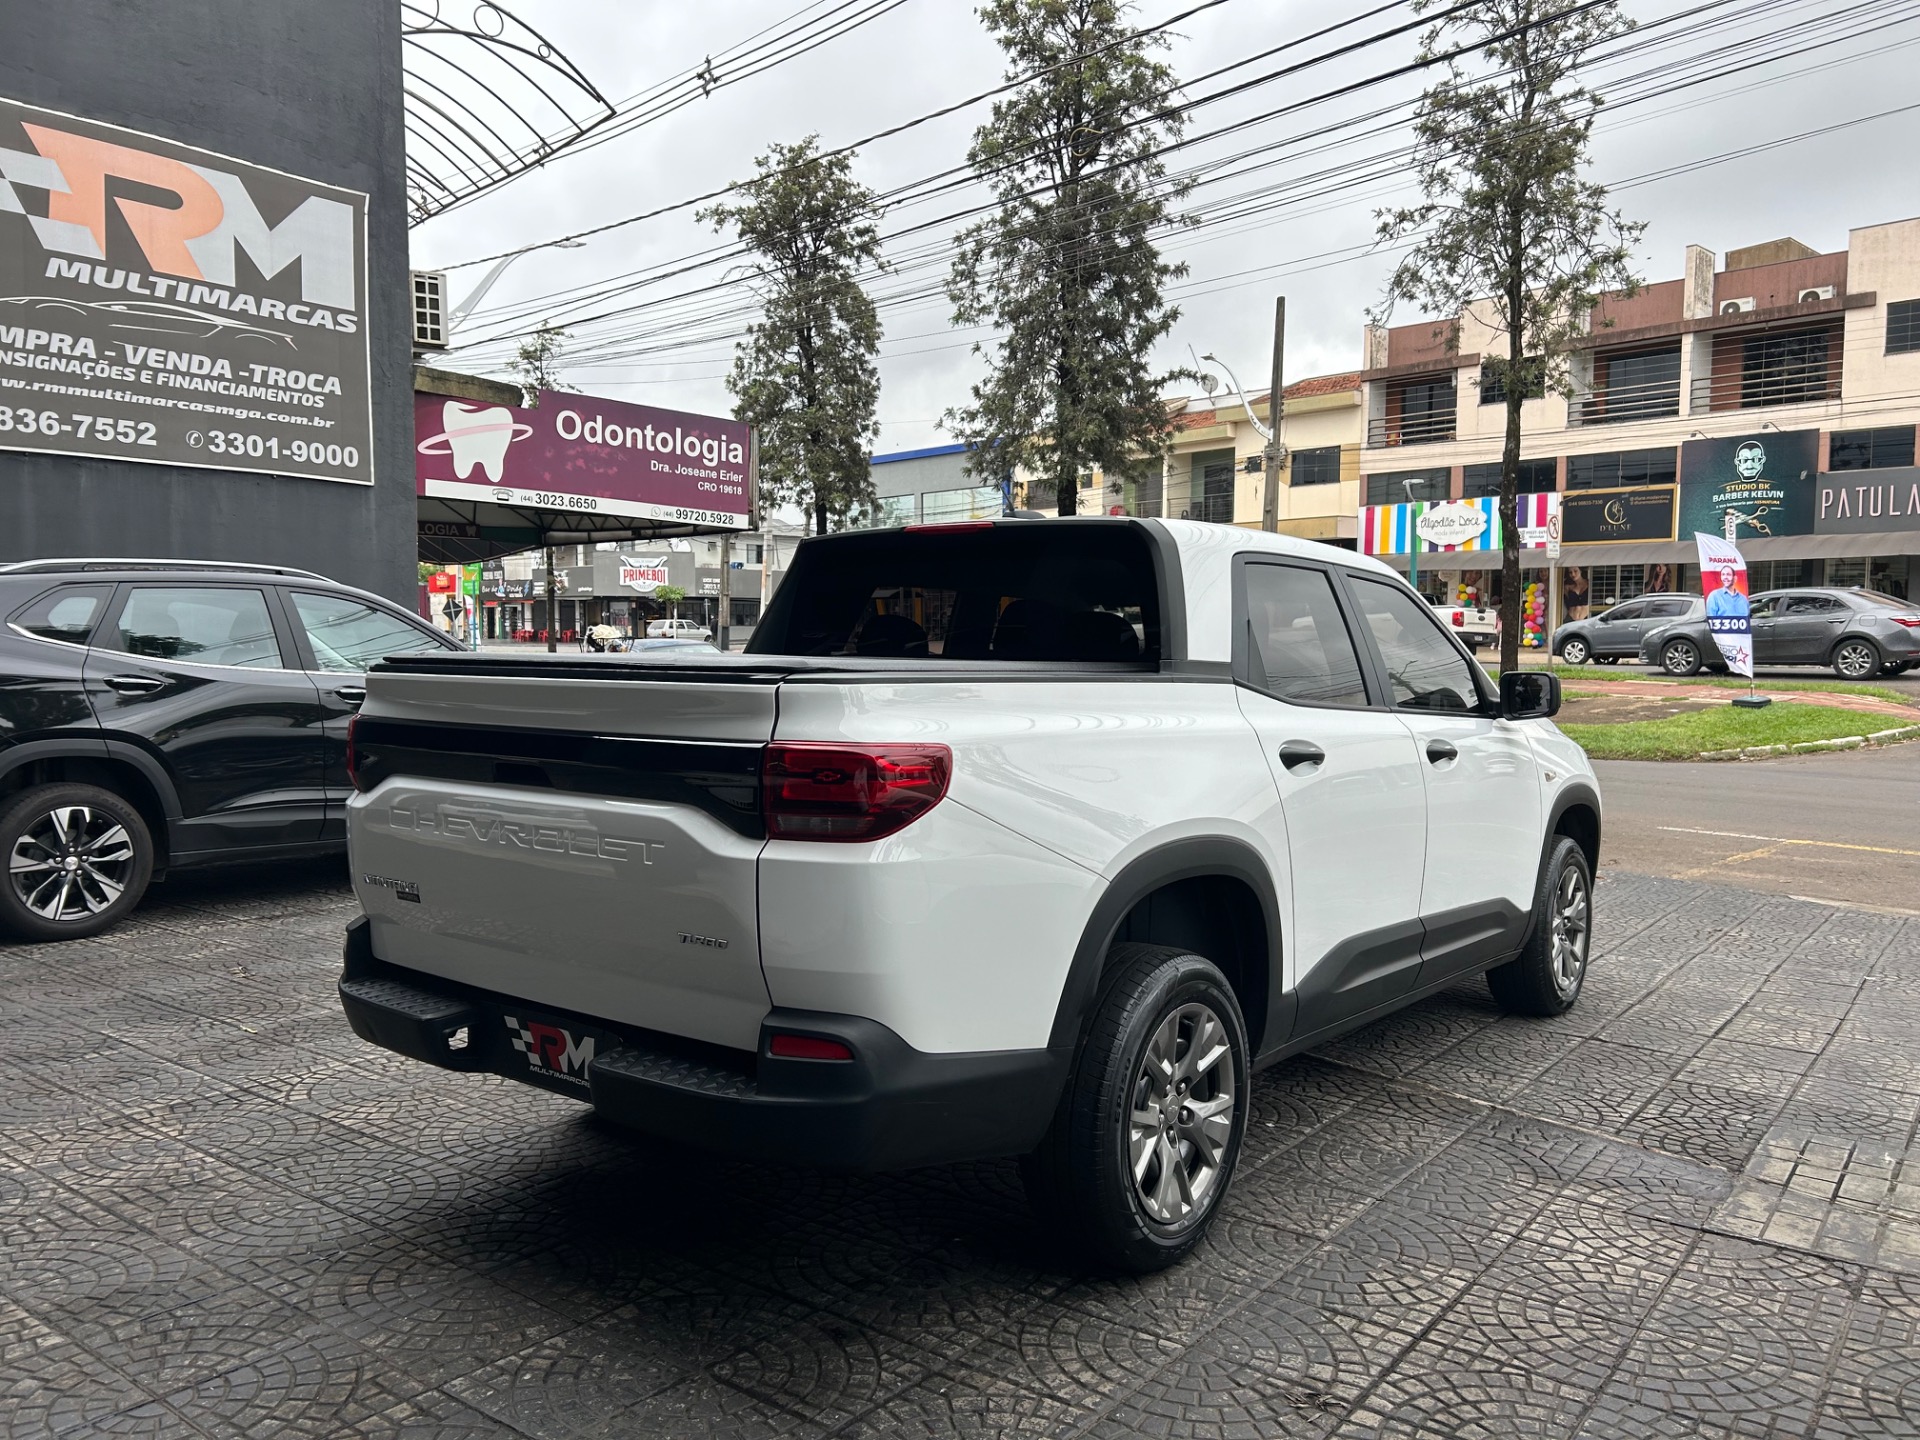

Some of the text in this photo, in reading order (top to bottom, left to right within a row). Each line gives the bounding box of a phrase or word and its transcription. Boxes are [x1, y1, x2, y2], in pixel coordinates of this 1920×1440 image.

[21, 121, 355, 311] RM
[46, 257, 358, 333] MULTIMARCAS
[124, 344, 232, 379] VENDA
[0, 377, 335, 429] w.rmmultimarcasmga.com.br
[139, 370, 153, 384] E
[156, 371, 325, 409] FINANCIAMENTOS
[0, 405, 157, 446] 836-7552
[555, 409, 744, 468] Odontologia
[208, 430, 359, 468] 3301-9000
[650, 460, 743, 483] Dra. Joseane Erler
[520, 492, 597, 510] (44) 3023.6650
[697, 481, 742, 495] CRO 19618
[1712, 490, 1784, 503] BARBER KELVIN
[1725, 483, 1757, 492] STUDIO
[1821, 484, 1920, 520] PATULA
[663, 508, 735, 525] (44) 99720.5928
[1459, 515, 1481, 527] Doce
[1708, 556, 1738, 564] PARANÁ
[623, 568, 666, 584] PRIMEBOI
[1708, 619, 1748, 631] 13300
[389, 805, 665, 865] CHEVROLET
